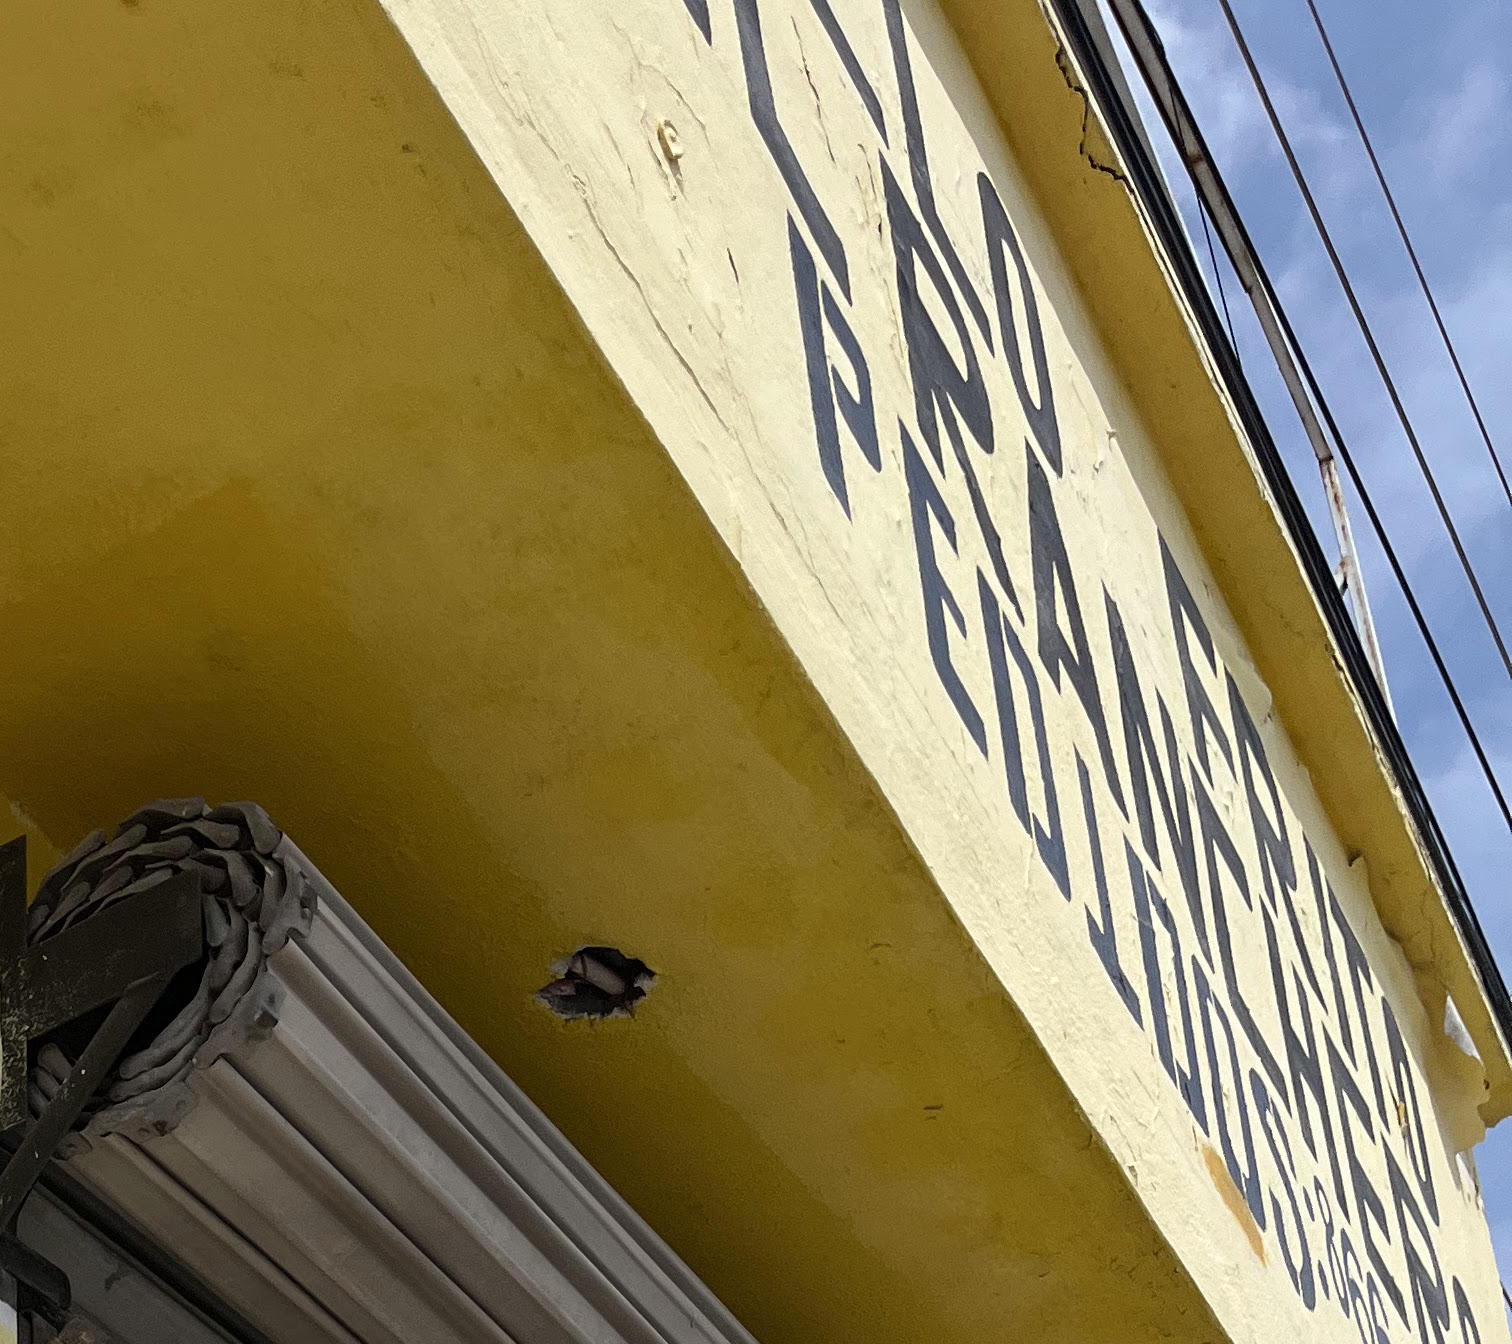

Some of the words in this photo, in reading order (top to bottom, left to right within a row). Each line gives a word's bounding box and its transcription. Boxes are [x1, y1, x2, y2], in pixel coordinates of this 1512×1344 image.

[684, 0, 852, 307] L
[806, 0, 1063, 479] LO
[1157, 526, 1439, 1227] FRITO
